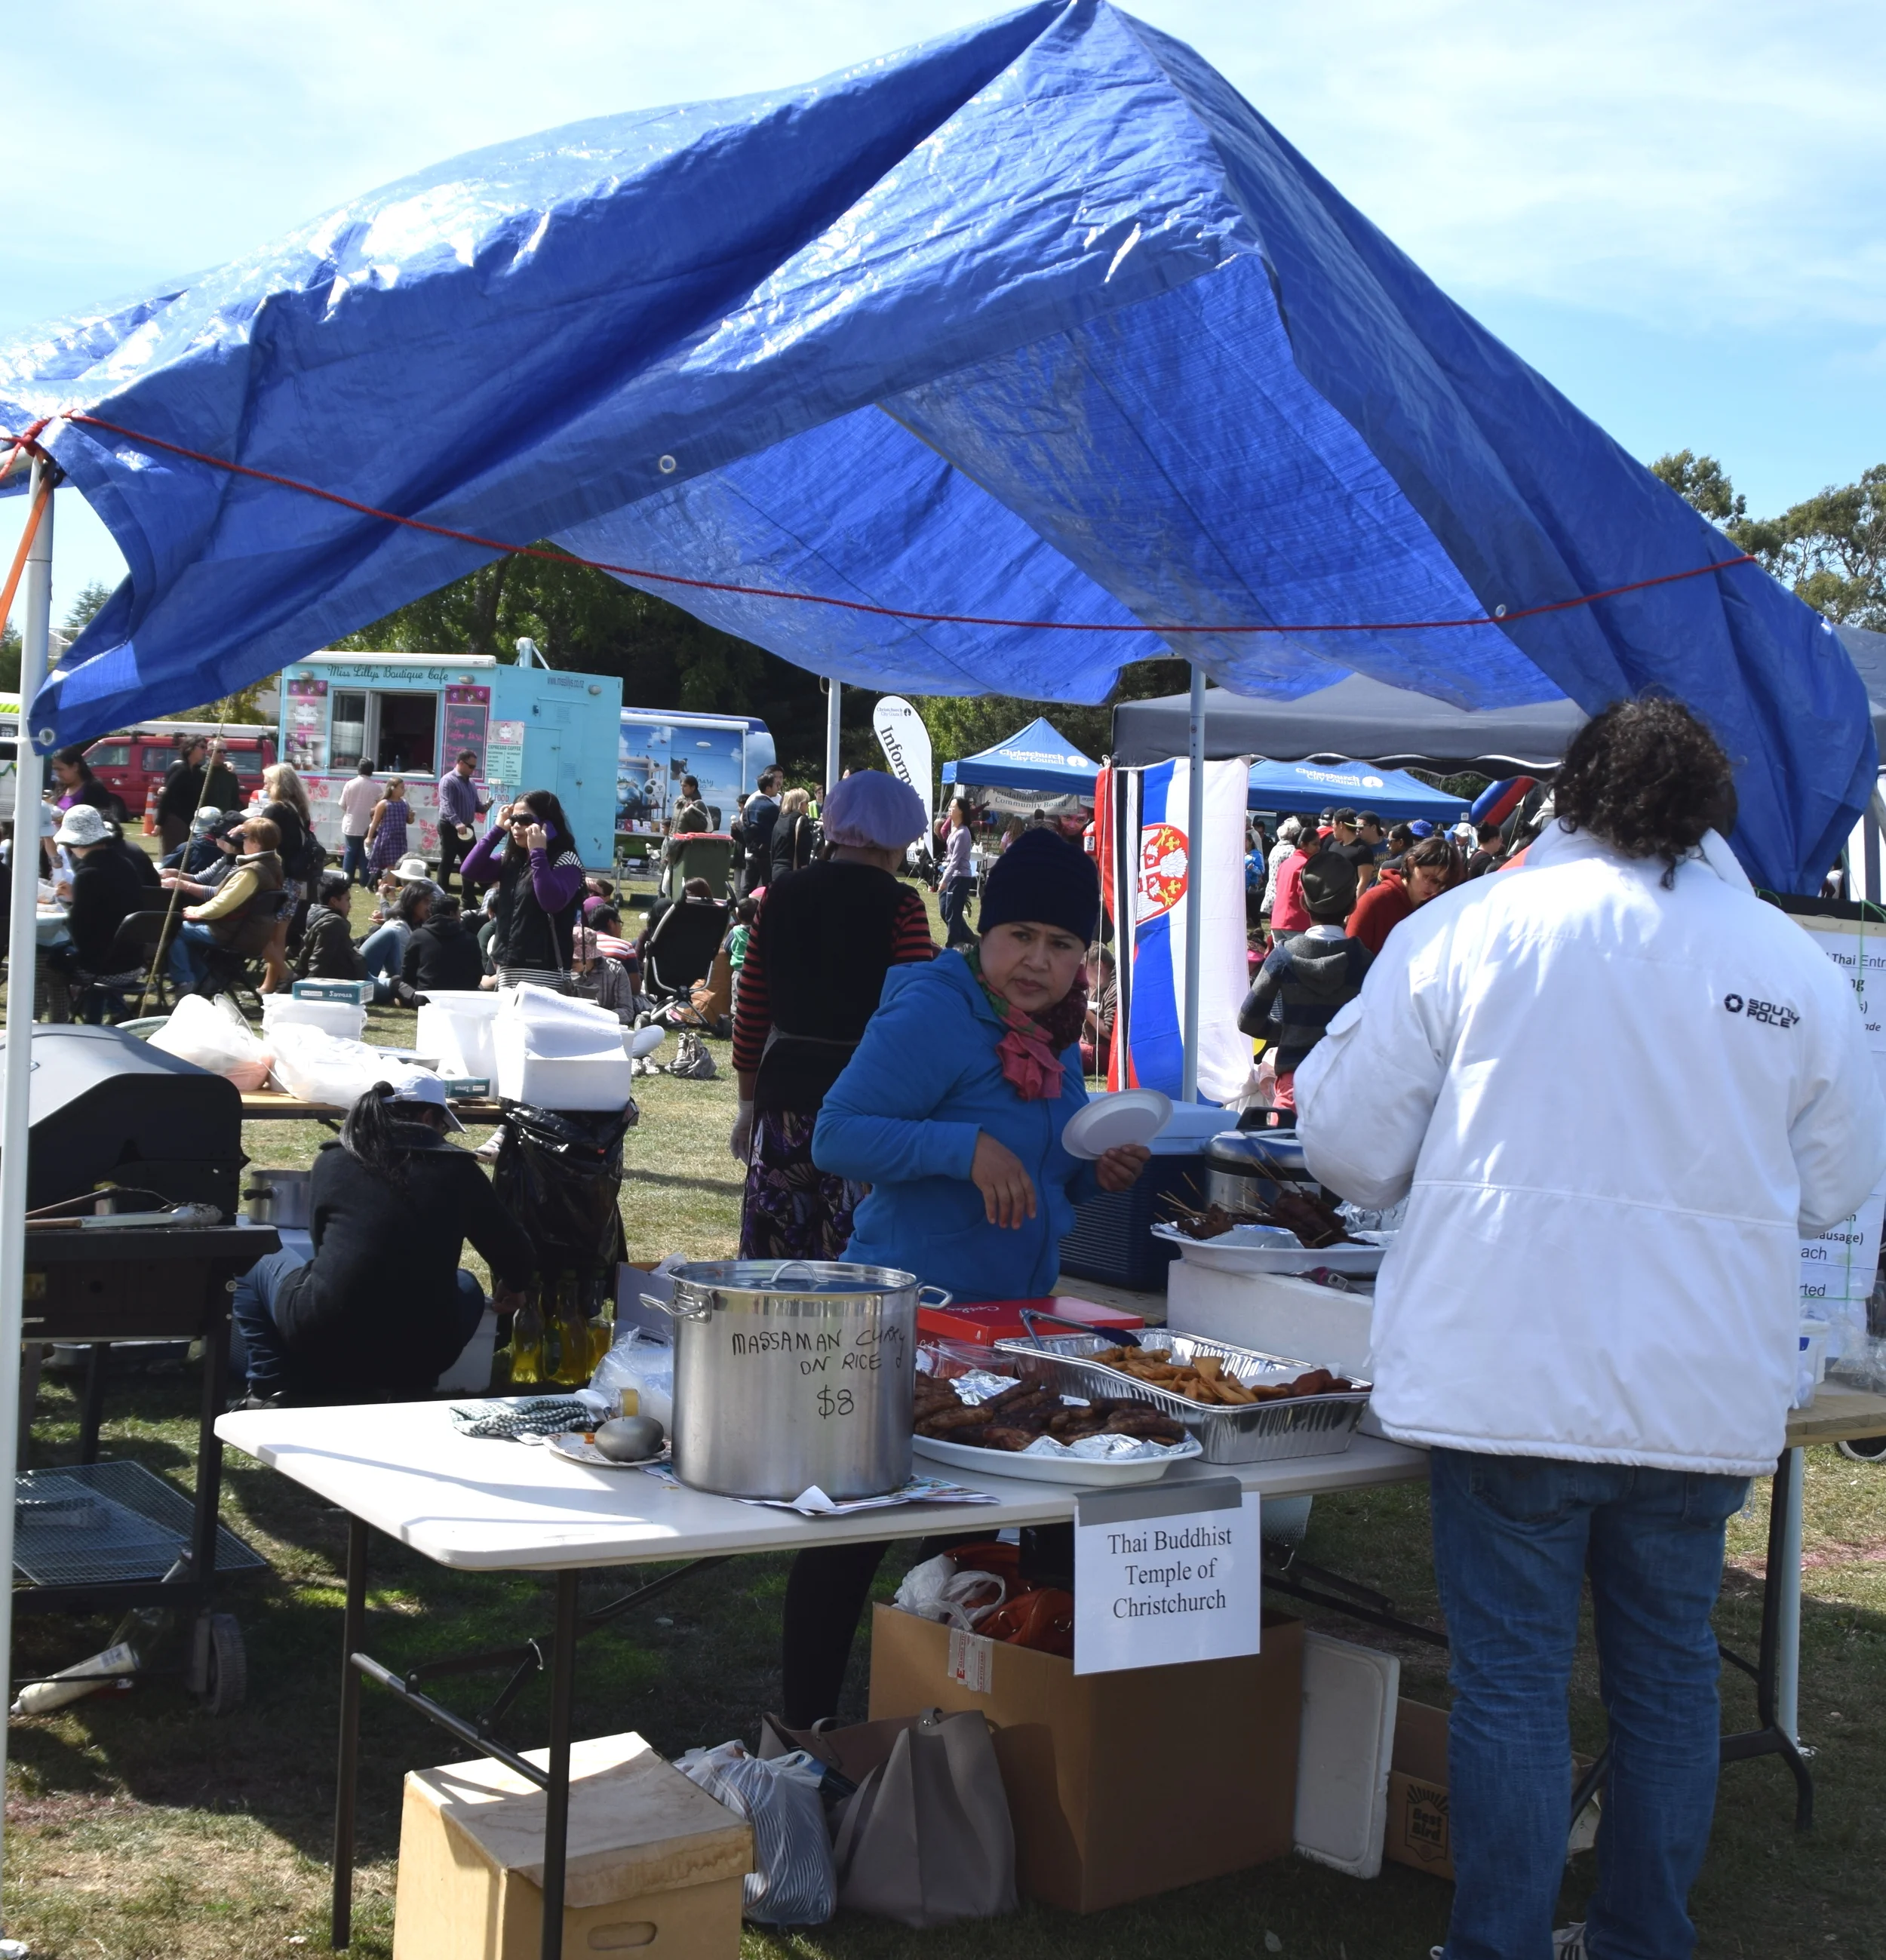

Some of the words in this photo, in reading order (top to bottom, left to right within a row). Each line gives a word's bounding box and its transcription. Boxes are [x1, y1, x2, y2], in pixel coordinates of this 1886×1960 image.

[327, 664, 350, 677] Miss
[353, 664, 379, 682] Lilly's
[383, 665, 423, 683] Boutique
[428, 667, 449, 684] Cafe
[880, 725, 914, 789] Inform
[999, 749, 1064, 760] Christchurch
[1030, 756, 1064, 765] Council
[1295, 767, 1359, 782] Christchurch
[1326, 777, 1361, 786] Council
[995, 797, 1042, 809] Community
[1832, 954, 1856, 965] Thai
[1746, 1008, 1791, 1028] POLE
[1816, 1232, 1863, 1246] ausage)
[732, 1329, 842, 1355] MASSAMAN
[800, 1356, 831, 1375] ON
[842, 1352, 881, 1370] RICE
[817, 1384, 854, 1419] $8
[1107, 1531, 1148, 1554] Thai
[1153, 1525, 1233, 1551] Buddhist
[1125, 1561, 1192, 1587] Temple
[1197, 1558, 1218, 1578] of
[1113, 1589, 1227, 1618] Christchurch
[1413, 1808, 1442, 1828] Best
[1412, 1821, 1442, 1842] Bird
